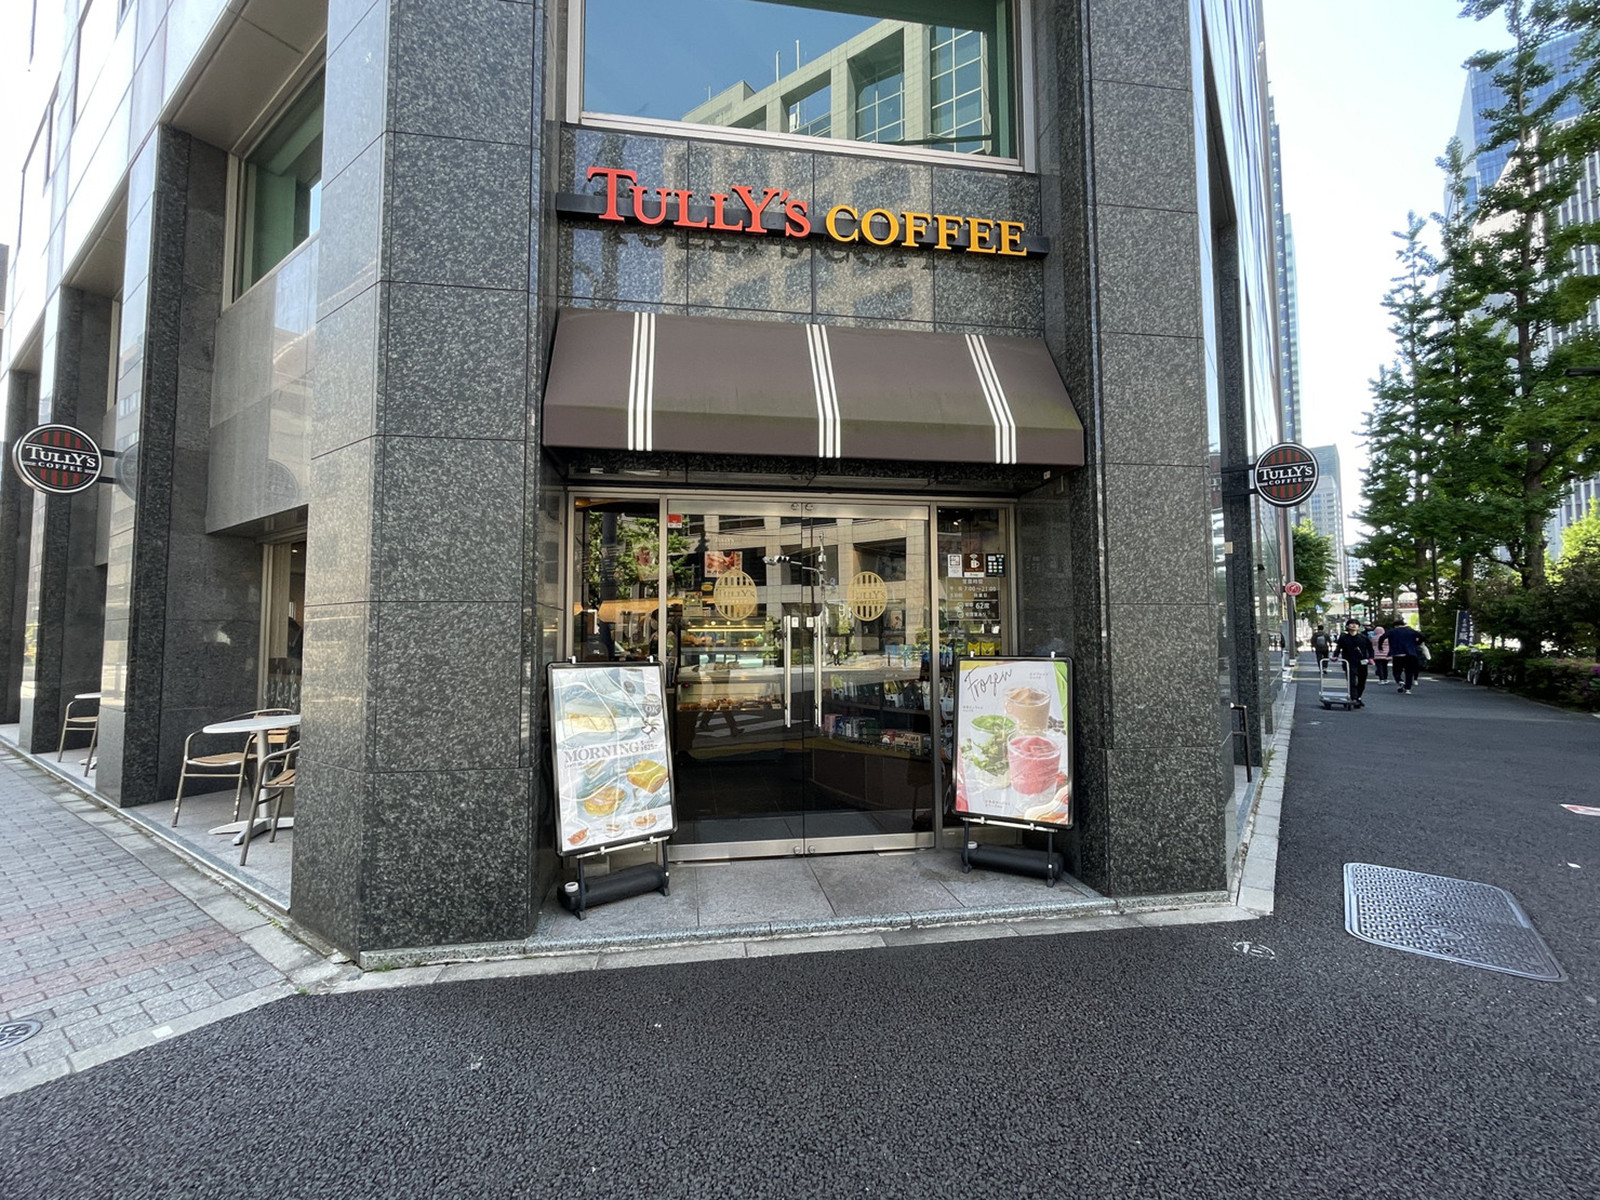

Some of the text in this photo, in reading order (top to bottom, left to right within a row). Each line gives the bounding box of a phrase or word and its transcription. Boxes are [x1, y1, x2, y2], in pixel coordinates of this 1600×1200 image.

[587, 166, 1028, 256] TULLY'S COFFEE
[25, 445, 96, 468] TULLY'S
[38, 461, 83, 473] COFFEE
[1259, 465, 1313, 481] TULLY'S
[1269, 477, 1303, 486] COFFEE
[964, 664, 1013, 702] Frozen
[645, 704, 660, 714] OK
[564, 741, 640, 763] MORNING
